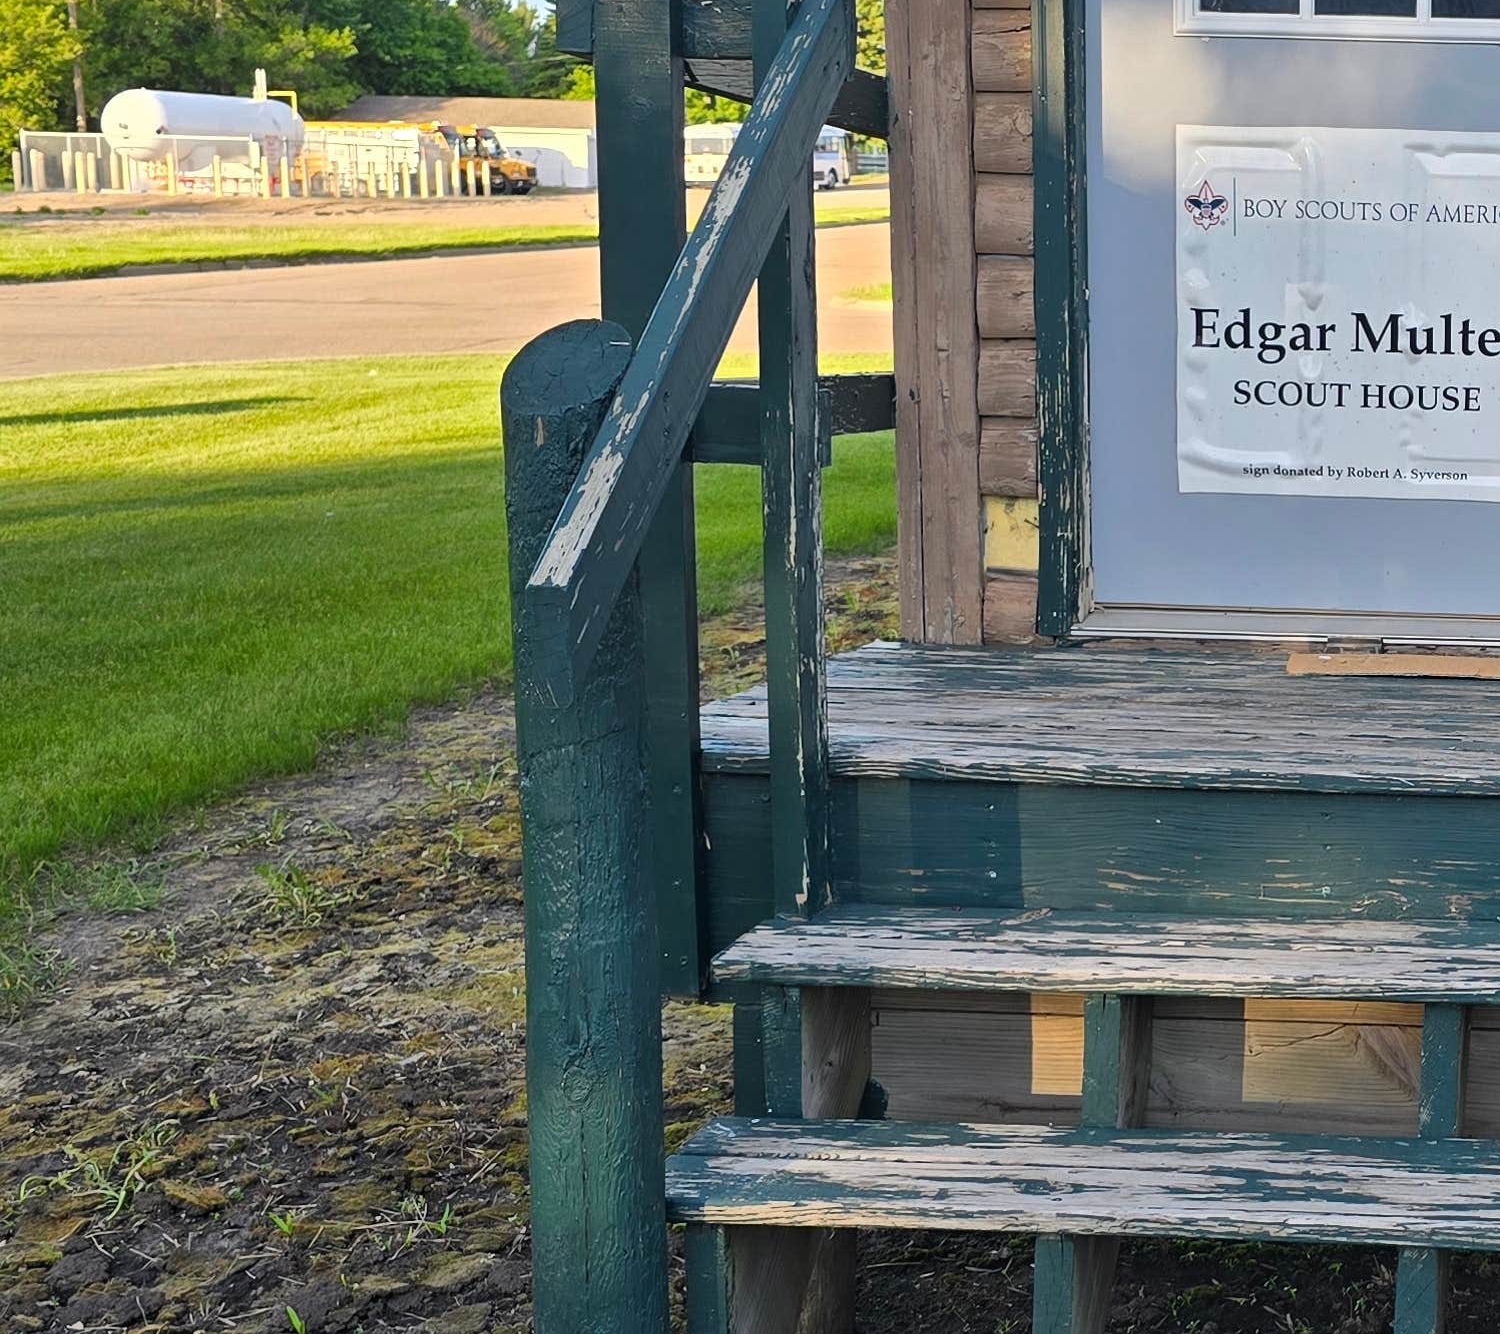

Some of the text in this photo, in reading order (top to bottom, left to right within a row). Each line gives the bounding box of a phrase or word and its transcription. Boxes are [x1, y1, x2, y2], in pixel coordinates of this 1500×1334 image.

[1244, 199, 1287, 218] BOY
[1296, 200, 1382, 222] SCOUTS
[1390, 203, 1420, 222] OF
[1189, 308, 1336, 364] Edgar
[1233, 380, 1481, 412] SCOUT HOUSE
[1242, 464, 1468, 482] sign donated by Robert A. Syverson
